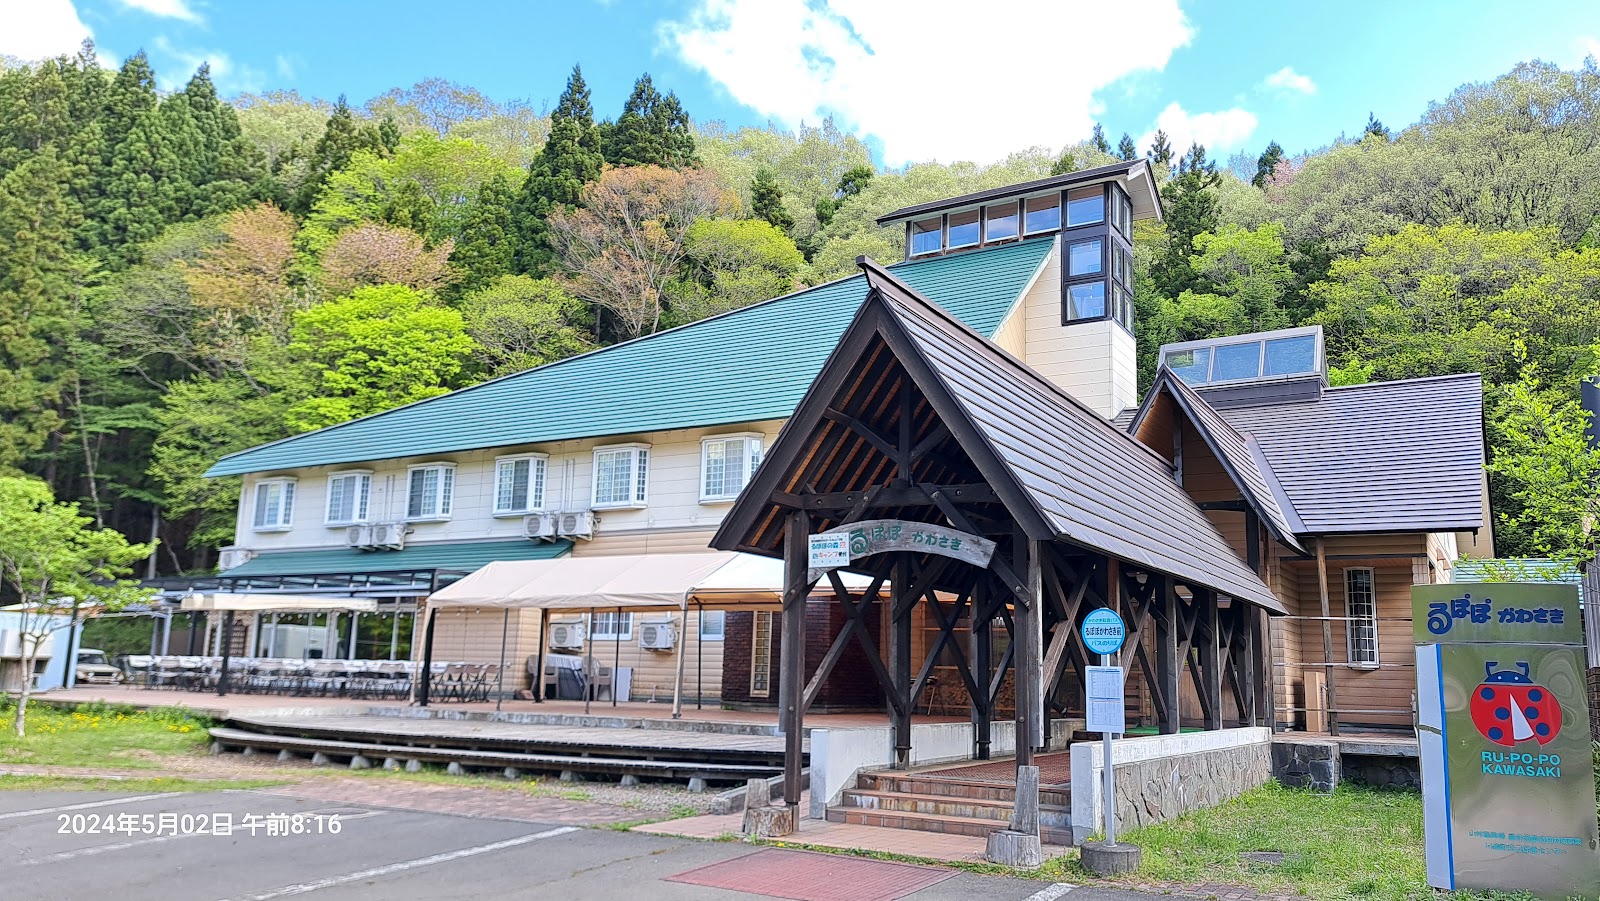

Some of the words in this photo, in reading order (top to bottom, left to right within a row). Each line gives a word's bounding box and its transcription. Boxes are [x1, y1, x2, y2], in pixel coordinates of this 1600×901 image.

[850, 521, 902, 554] るぽぽ
[912, 531, 962, 551] かわさき
[1427, 593, 1492, 635] るぽぽ
[1498, 607, 1564, 624] かわさき
[1481, 751, 1561, 766] RU-PO-PO
[1481, 763, 1561, 778] KAWASAKI
